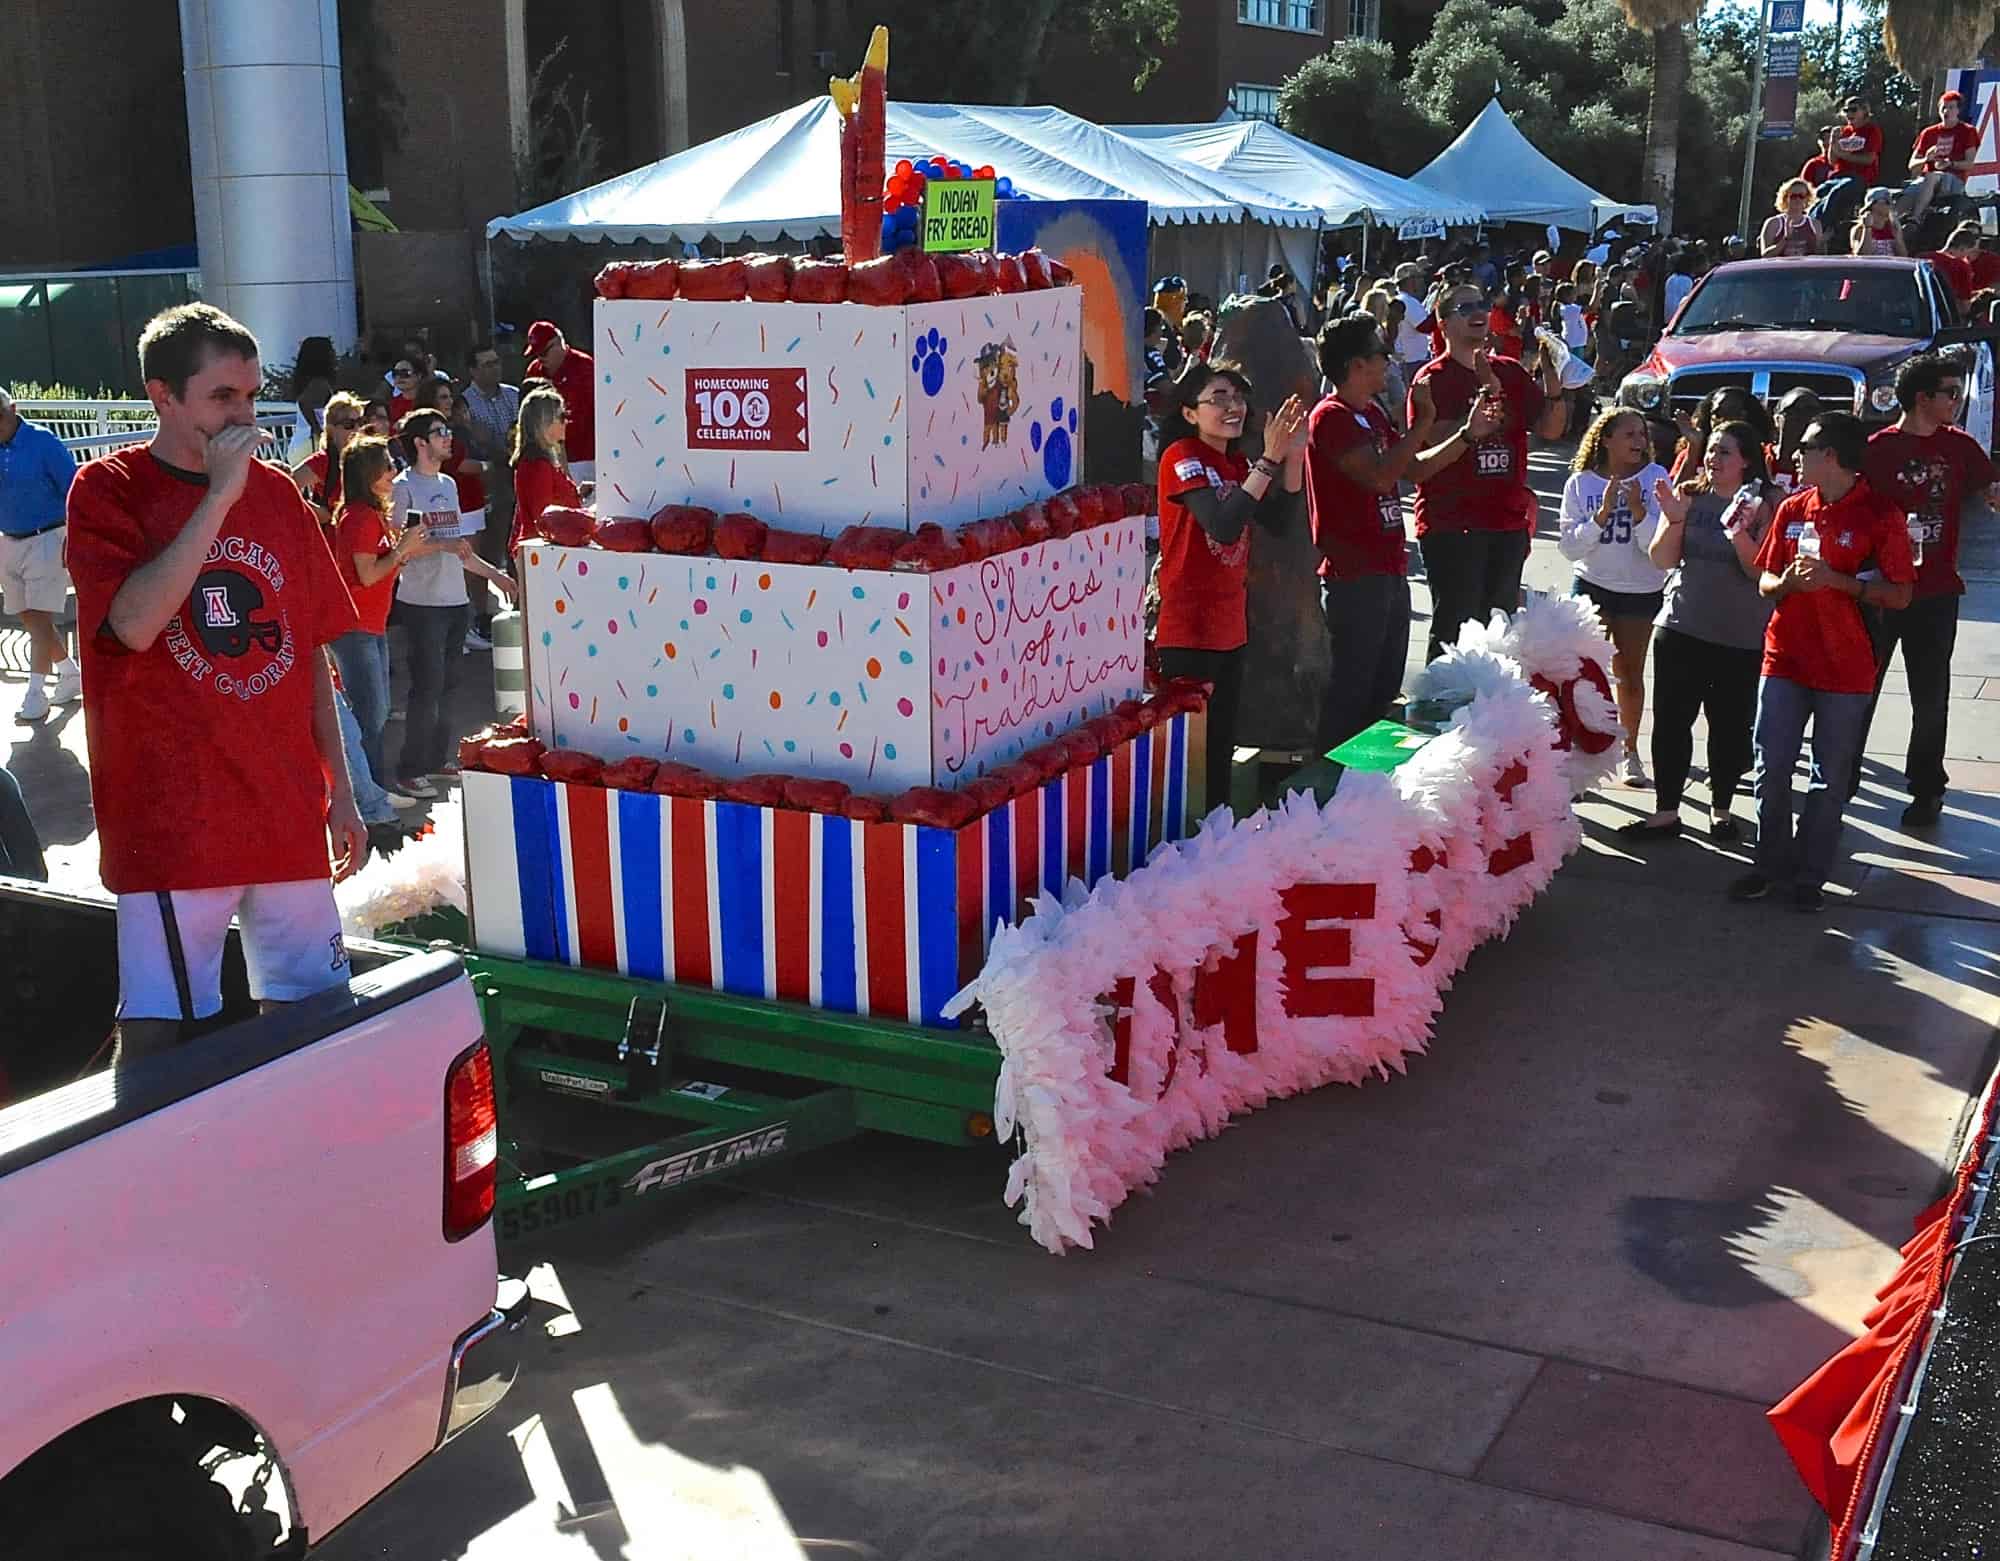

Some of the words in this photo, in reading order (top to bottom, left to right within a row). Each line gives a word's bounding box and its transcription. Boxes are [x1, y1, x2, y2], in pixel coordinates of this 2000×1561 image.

[940, 190, 979, 213] INDIAN
[927, 218, 948, 241] FRY
[951, 216, 988, 240] BREAD
[694, 379, 769, 390] HOMECOMING
[695, 391, 770, 427] 100
[696, 429, 771, 440] CELEBRATION
[1478, 454, 1510, 468] 100
[974, 559, 1103, 645] Slices
[1018, 619, 1056, 667] of
[944, 654, 1138, 773] Tradition
[626, 1122, 789, 1196] FELLING
